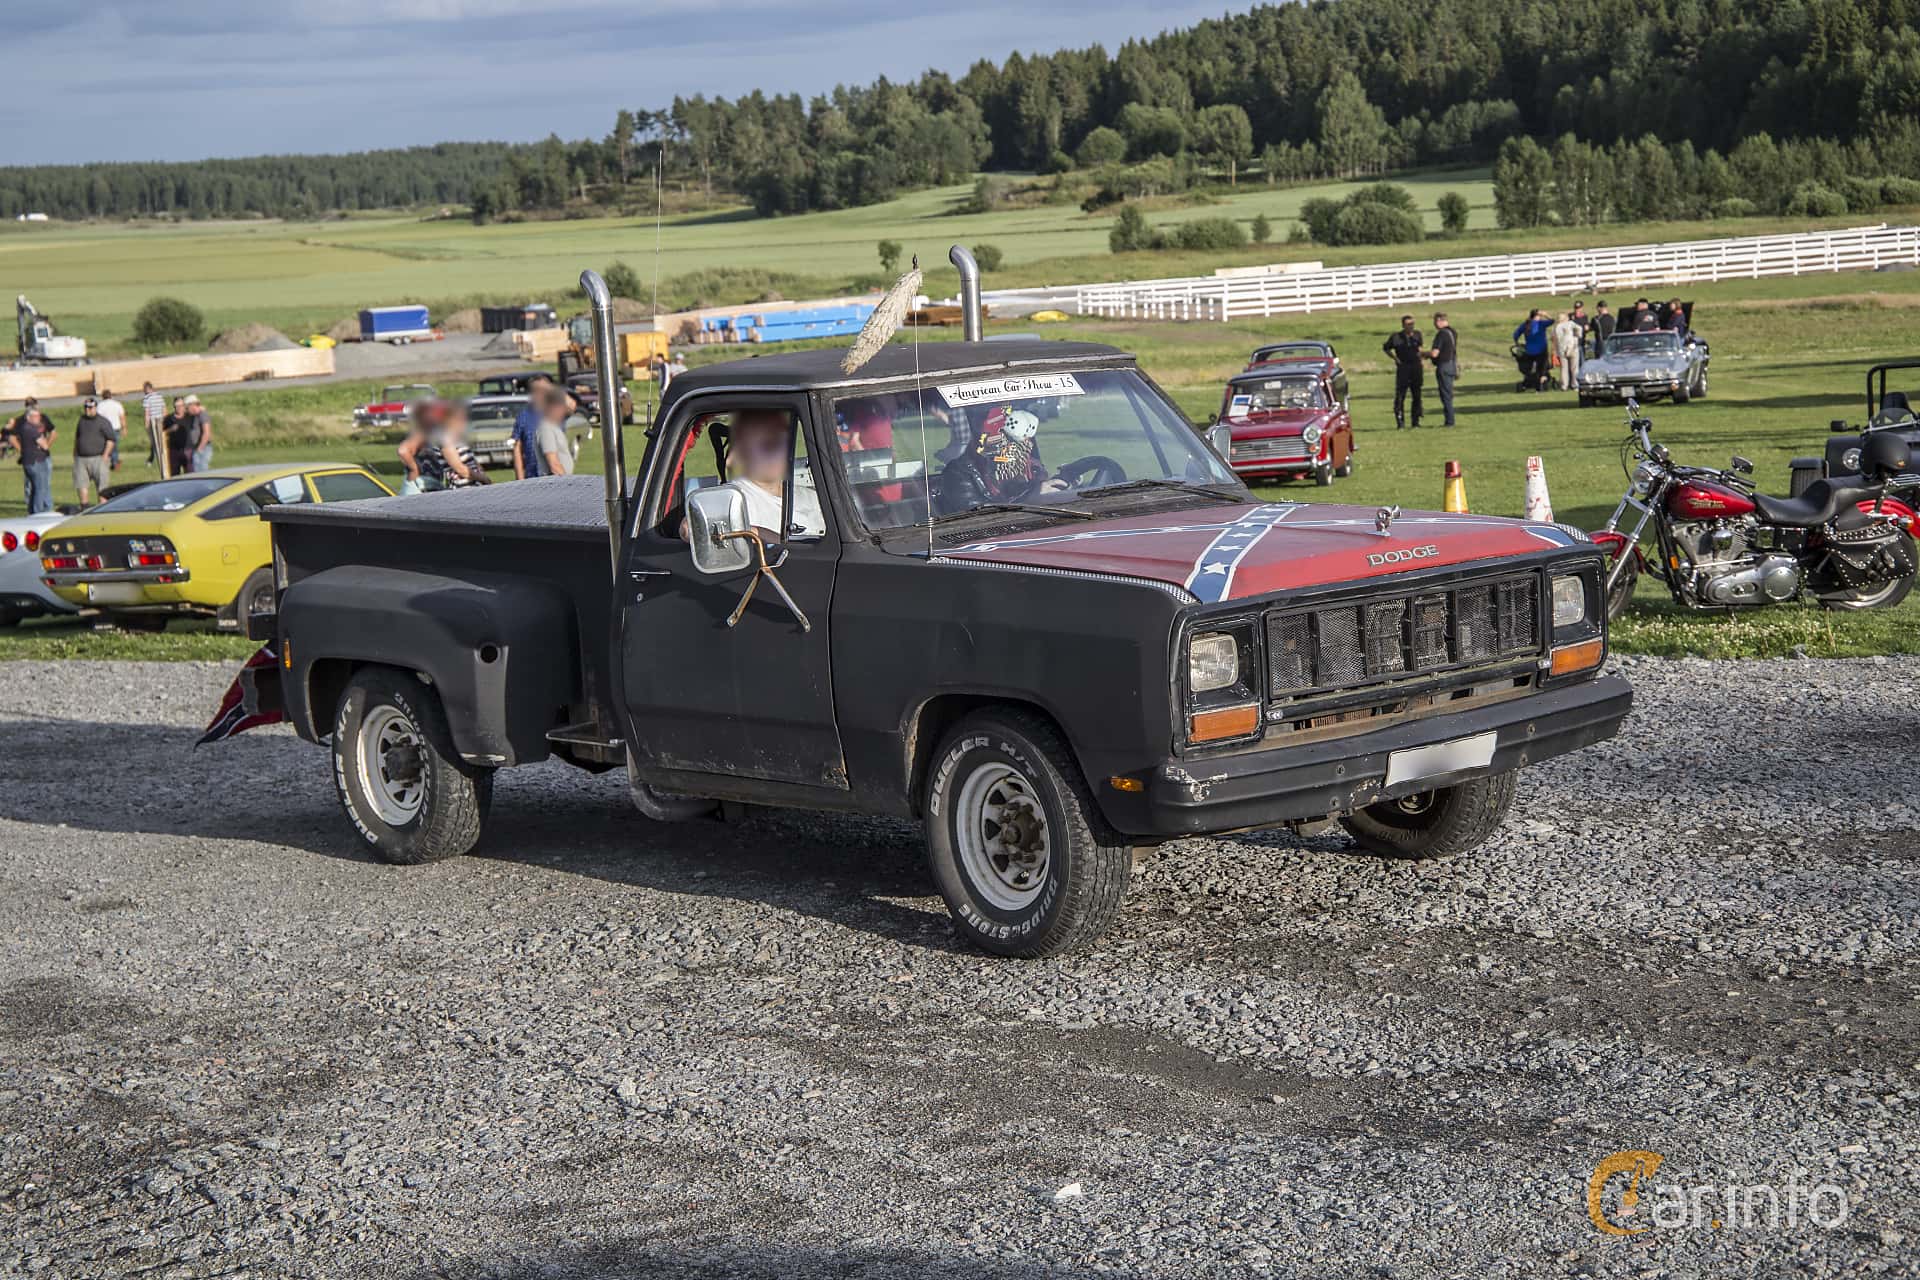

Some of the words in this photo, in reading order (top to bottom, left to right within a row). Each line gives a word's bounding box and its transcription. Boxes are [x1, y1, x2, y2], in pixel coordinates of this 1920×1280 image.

[949, 385, 1000, 400] American
[1004, 380, 1021, 392] Car
[1023, 379, 1052, 390] Show
[1366, 544, 1440, 567] DODGE
[930, 736, 990, 817] DUELER
